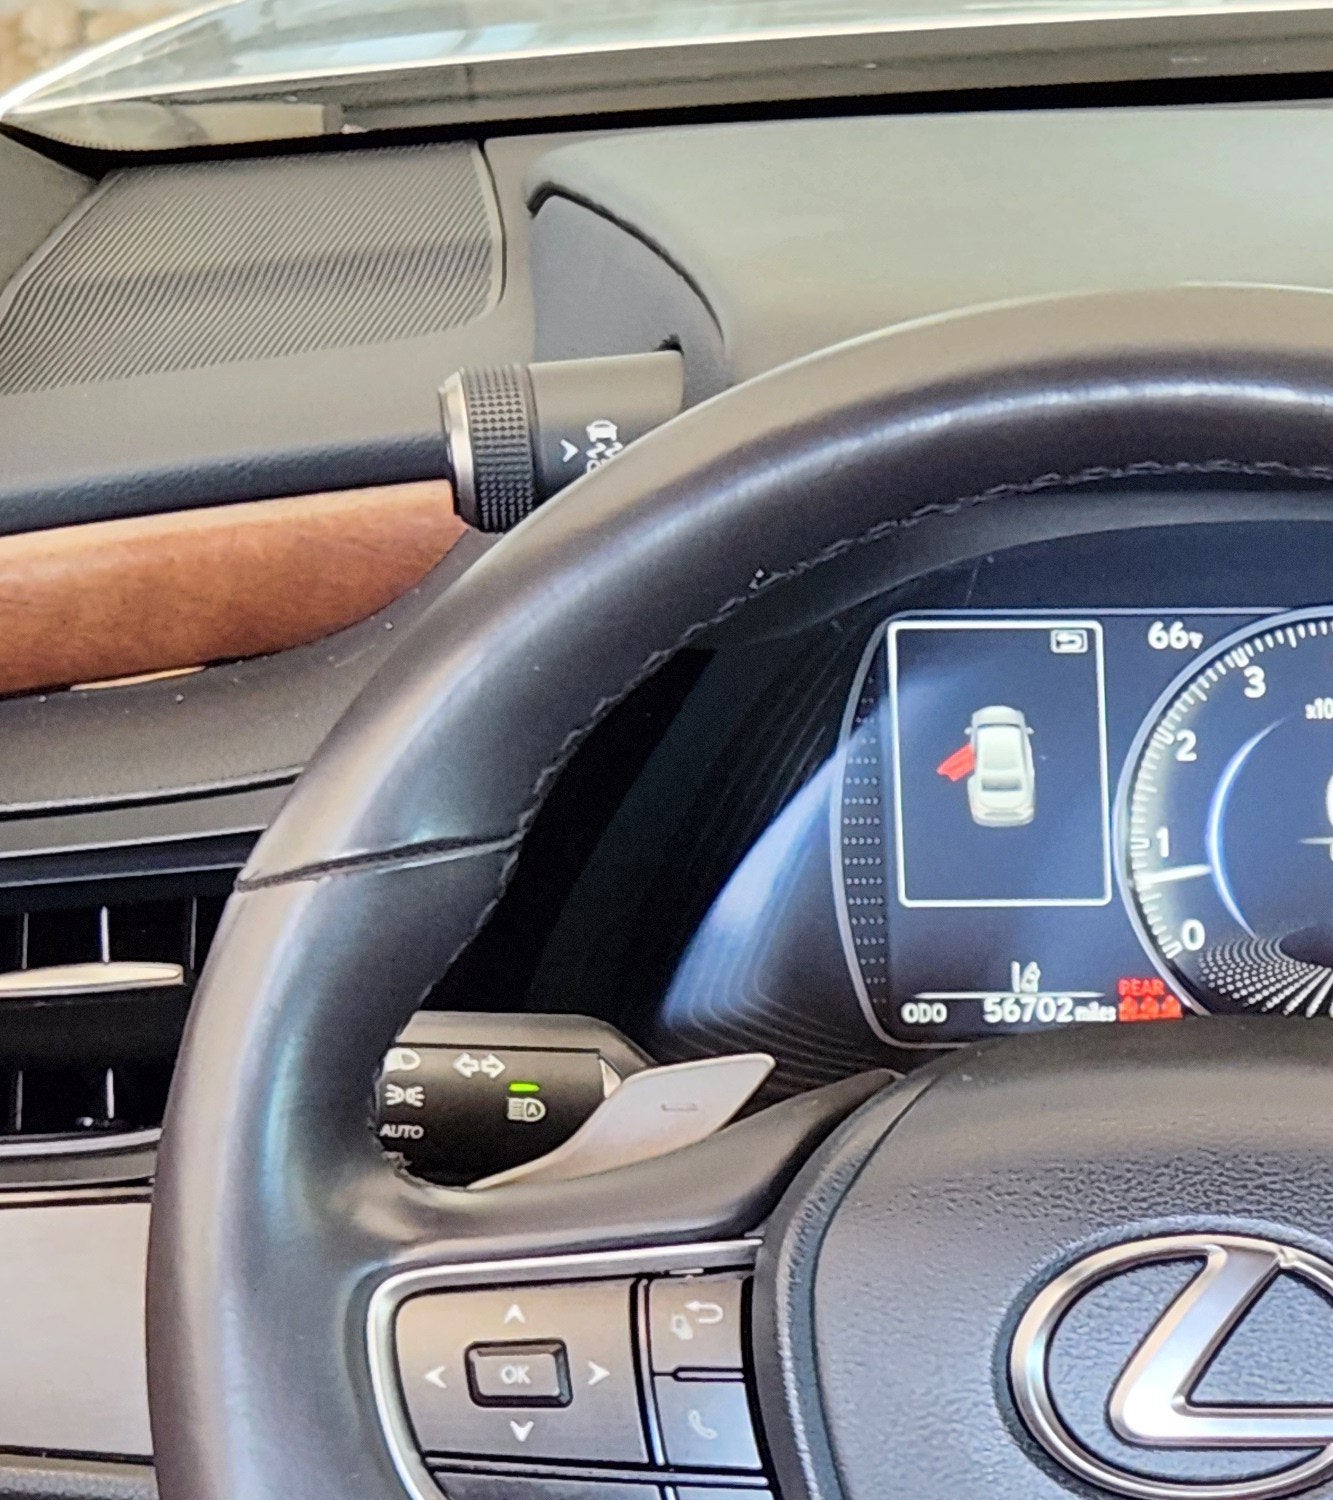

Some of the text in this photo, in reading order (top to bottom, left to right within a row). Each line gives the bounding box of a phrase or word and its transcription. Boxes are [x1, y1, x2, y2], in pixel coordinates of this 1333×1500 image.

[1244, 664, 1266, 698] 3
[1177, 733, 1198, 762] 2
[1156, 826, 1170, 858] 1
[1180, 918, 1206, 952] 0
[901, 1002, 948, 1024] ODO
[983, 996, 1074, 1024] 56702
[379, 1123, 425, 1139] AUTO
[499, 1364, 532, 1387] OK
